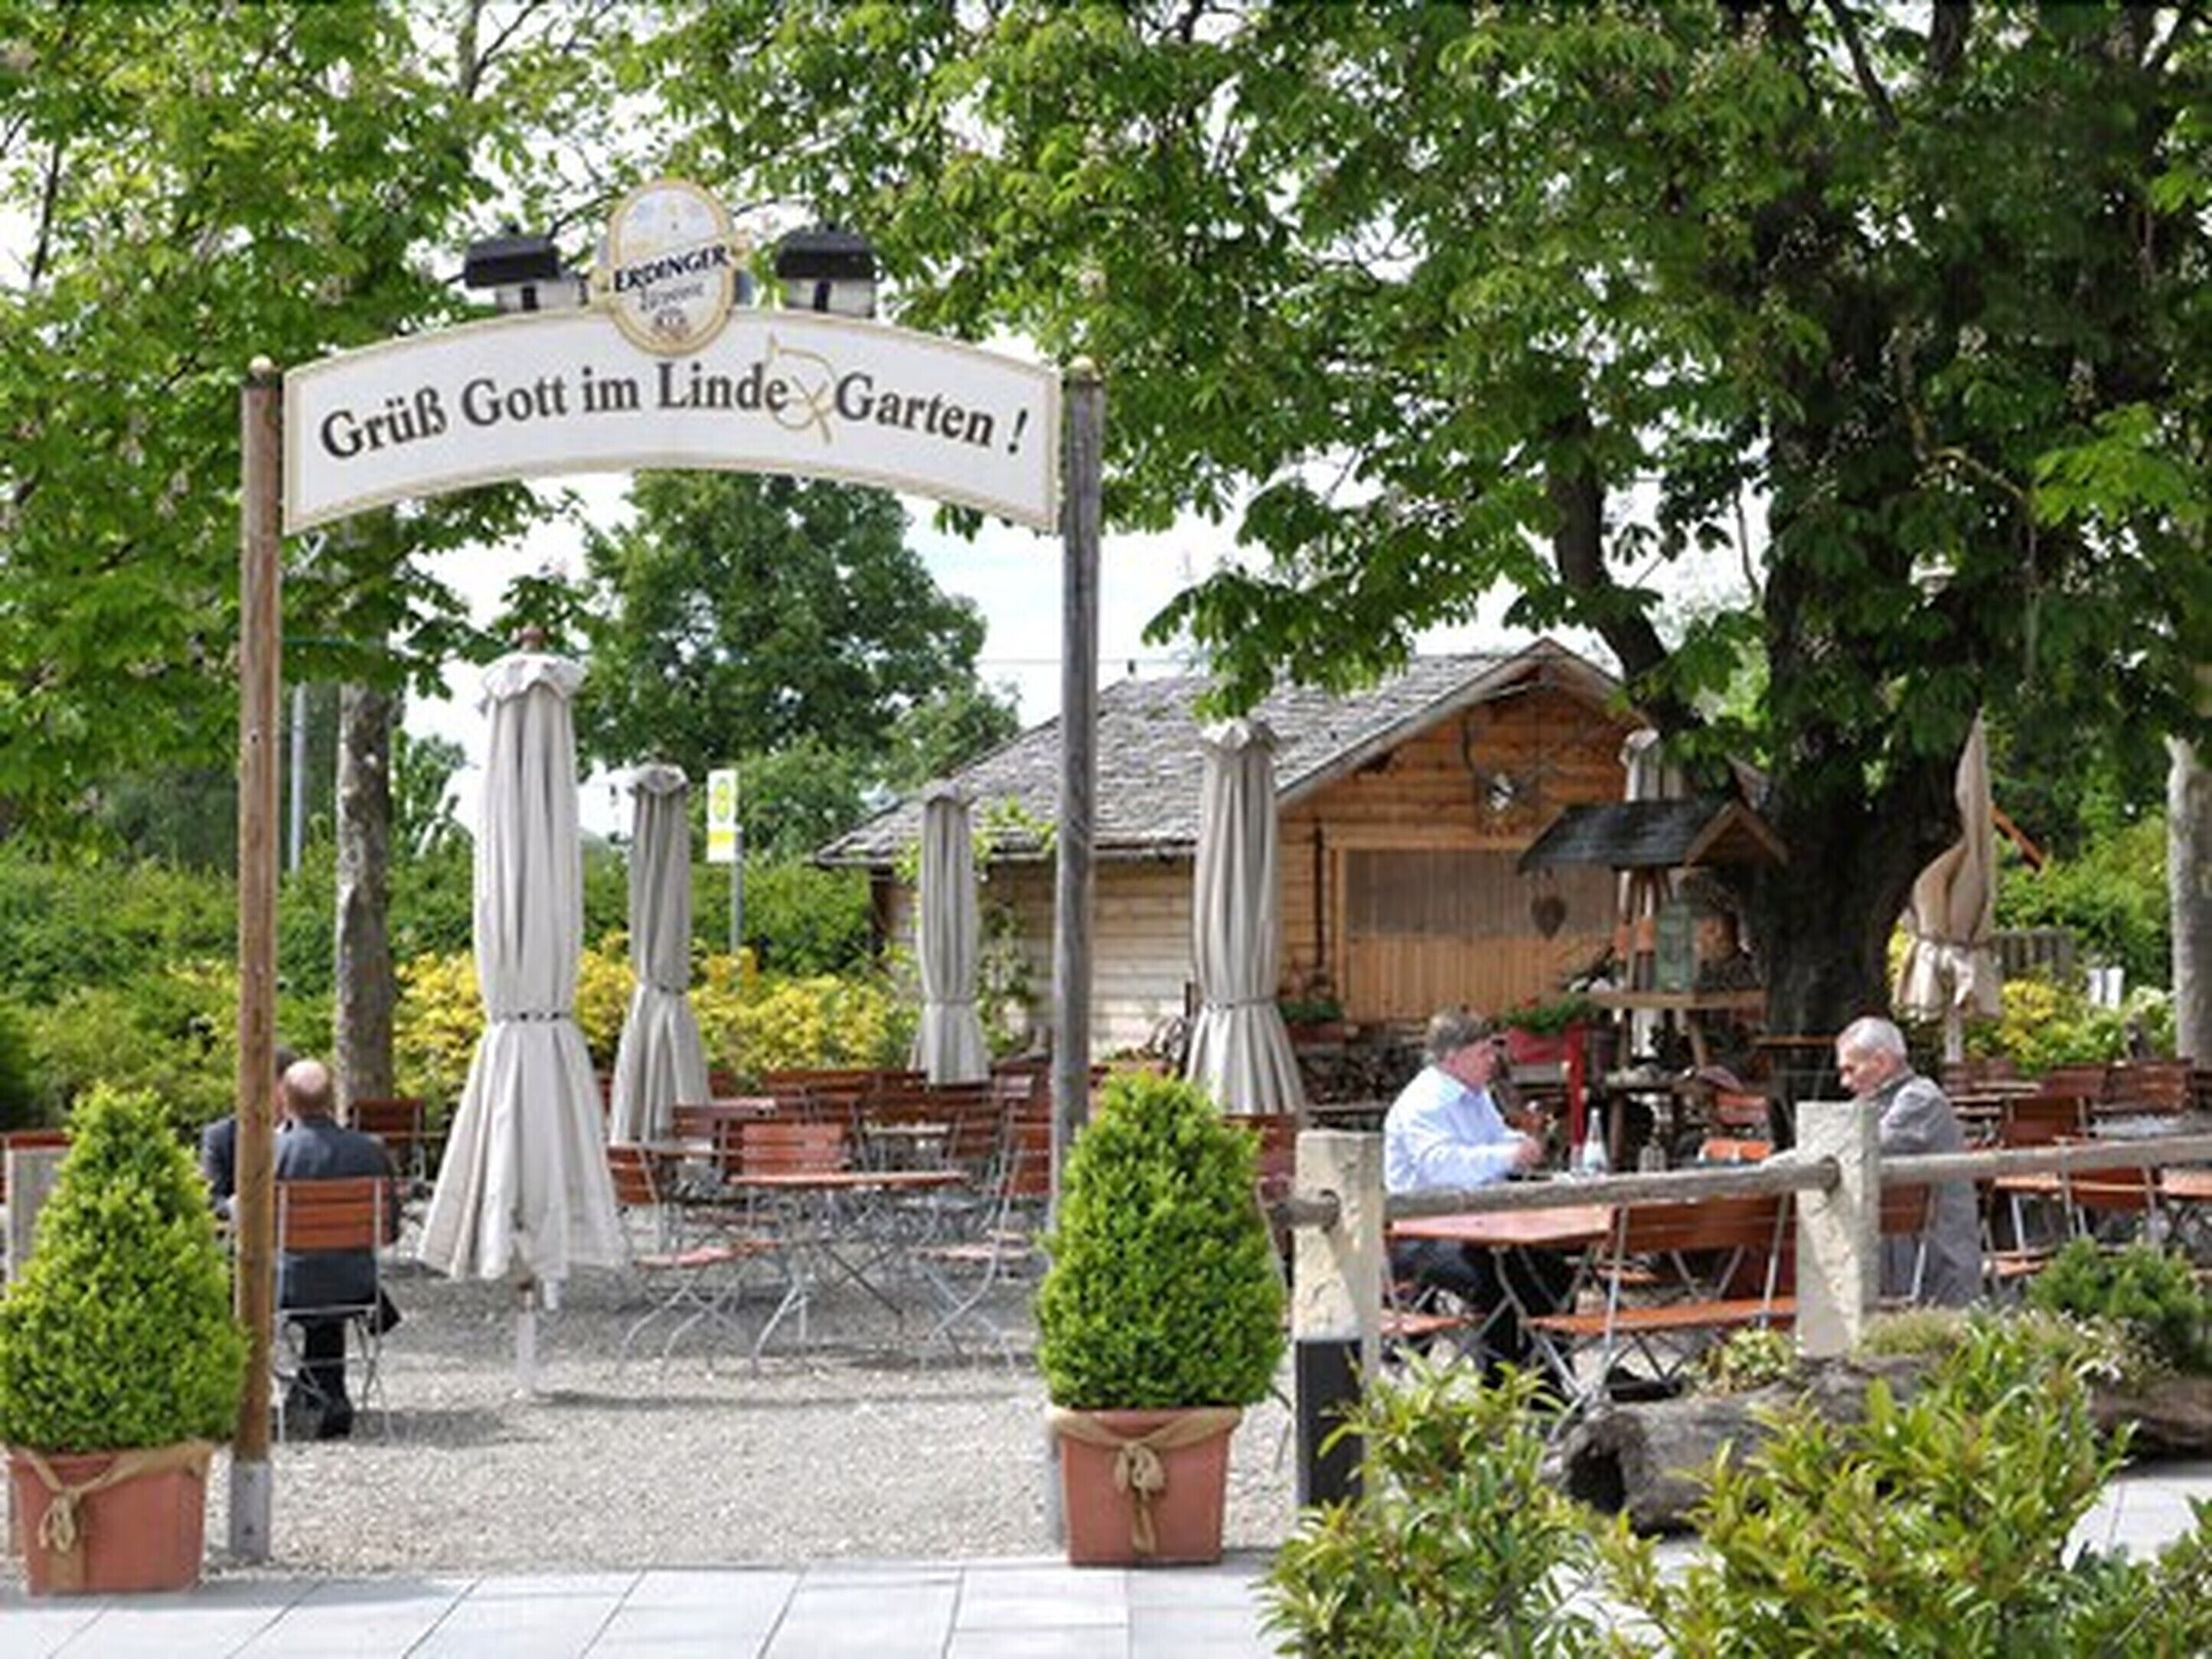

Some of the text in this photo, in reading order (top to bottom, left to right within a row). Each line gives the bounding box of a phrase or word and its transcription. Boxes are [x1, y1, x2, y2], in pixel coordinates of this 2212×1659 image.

[614, 244, 730, 292] ERDINGER
[320, 386, 447, 458] Grüß
[461, 375, 567, 426] Gott
[582, 366, 639, 413] im
[656, 361, 790, 411] Linde
[834, 371, 994, 447] Garten
